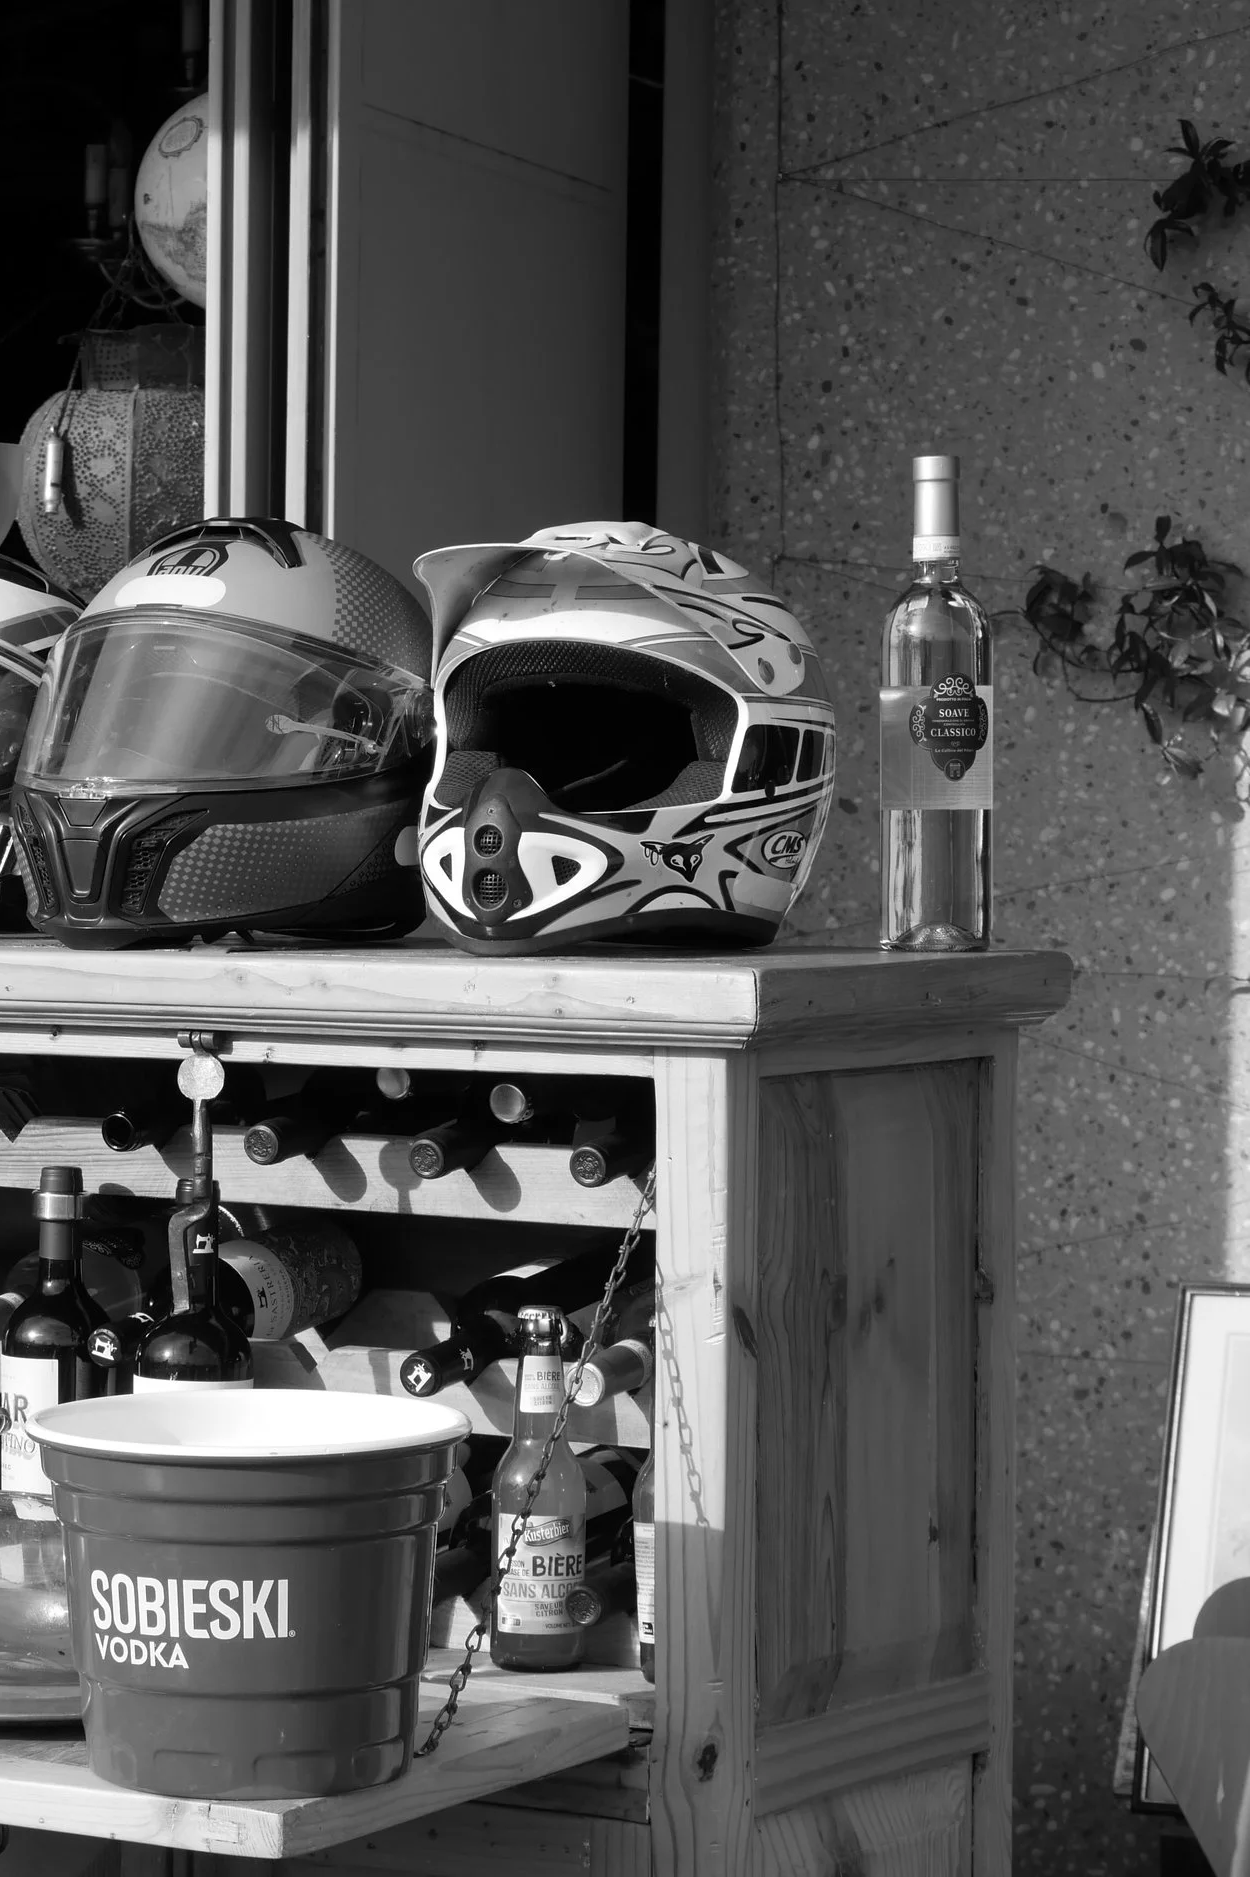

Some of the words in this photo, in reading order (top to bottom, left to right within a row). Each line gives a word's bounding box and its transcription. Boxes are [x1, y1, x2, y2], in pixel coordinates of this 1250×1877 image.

[939, 708, 969, 717] SOAVE
[930, 728, 976, 737] CLASSICO
[771, 835, 803, 855] CMS
[2, 1392, 29, 1423] AR
[525, 1522, 570, 1542] Kusterbier
[532, 1552, 583, 1577] BIÈRE
[503, 1581, 537, 1598] SANS
[91, 1569, 289, 1640] SOBIESKI
[534, 1602, 564, 1611] SAVEUR
[535, 1609, 564, 1618] CITRON
[95, 1633, 190, 1669] VODKA
